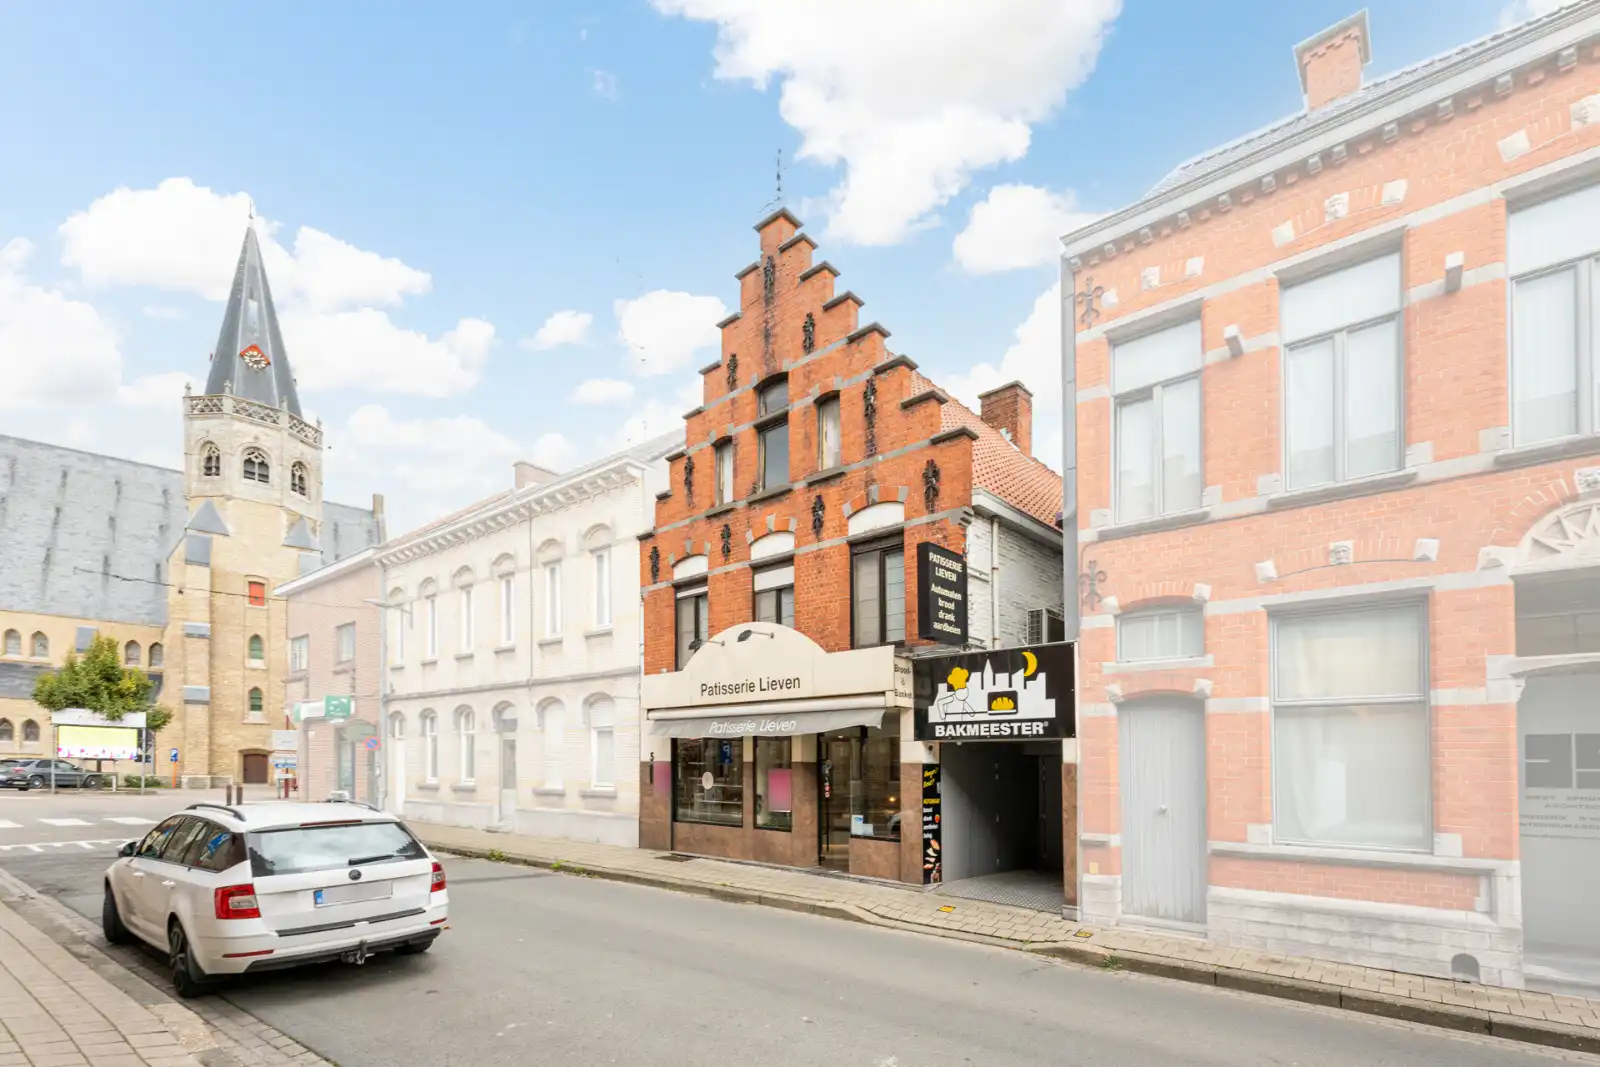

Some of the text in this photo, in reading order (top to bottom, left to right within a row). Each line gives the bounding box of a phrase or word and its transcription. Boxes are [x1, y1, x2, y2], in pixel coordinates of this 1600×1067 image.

[928, 552, 963, 572] PATISSERIE
[935, 567, 957, 582] LIEVEN
[930, 583, 962, 600] Automaten
[938, 597, 955, 610] brood
[938, 610, 955, 622] drank
[701, 675, 801, 697] Patisserie Lieven
[709, 719, 797, 734] Patisserie Lieven
